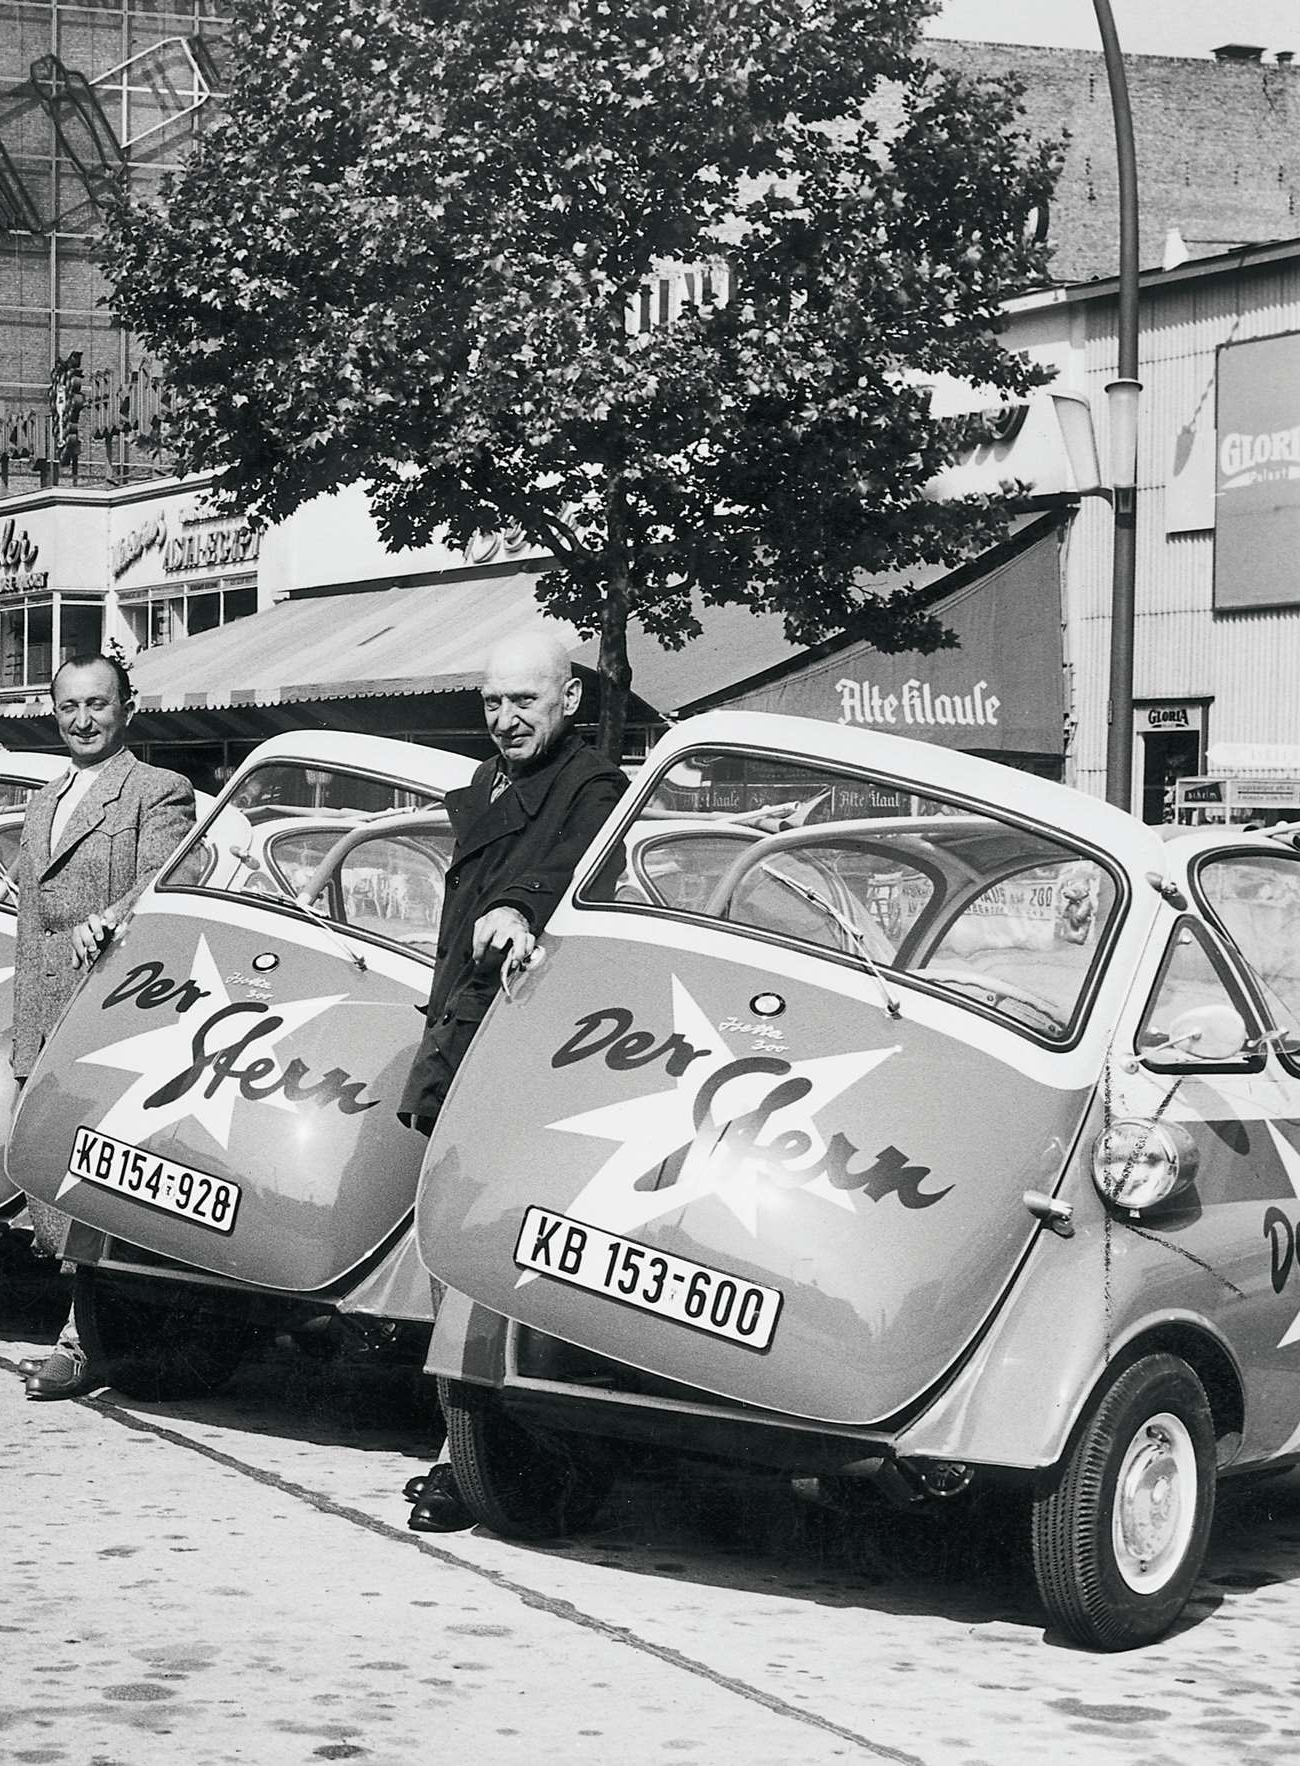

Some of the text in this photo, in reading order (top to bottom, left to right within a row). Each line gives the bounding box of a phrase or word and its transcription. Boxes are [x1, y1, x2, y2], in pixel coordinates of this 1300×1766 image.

[835, 678, 899, 726] Alte
[1148, 709, 1190, 726] GLORIA
[102, 961, 212, 1013] Der
[143, 1002, 381, 1115] Stern
[551, 1007, 712, 1077] Der
[633, 1056, 957, 1210] Stern
[530, 1216, 767, 1336] KB 153-600
